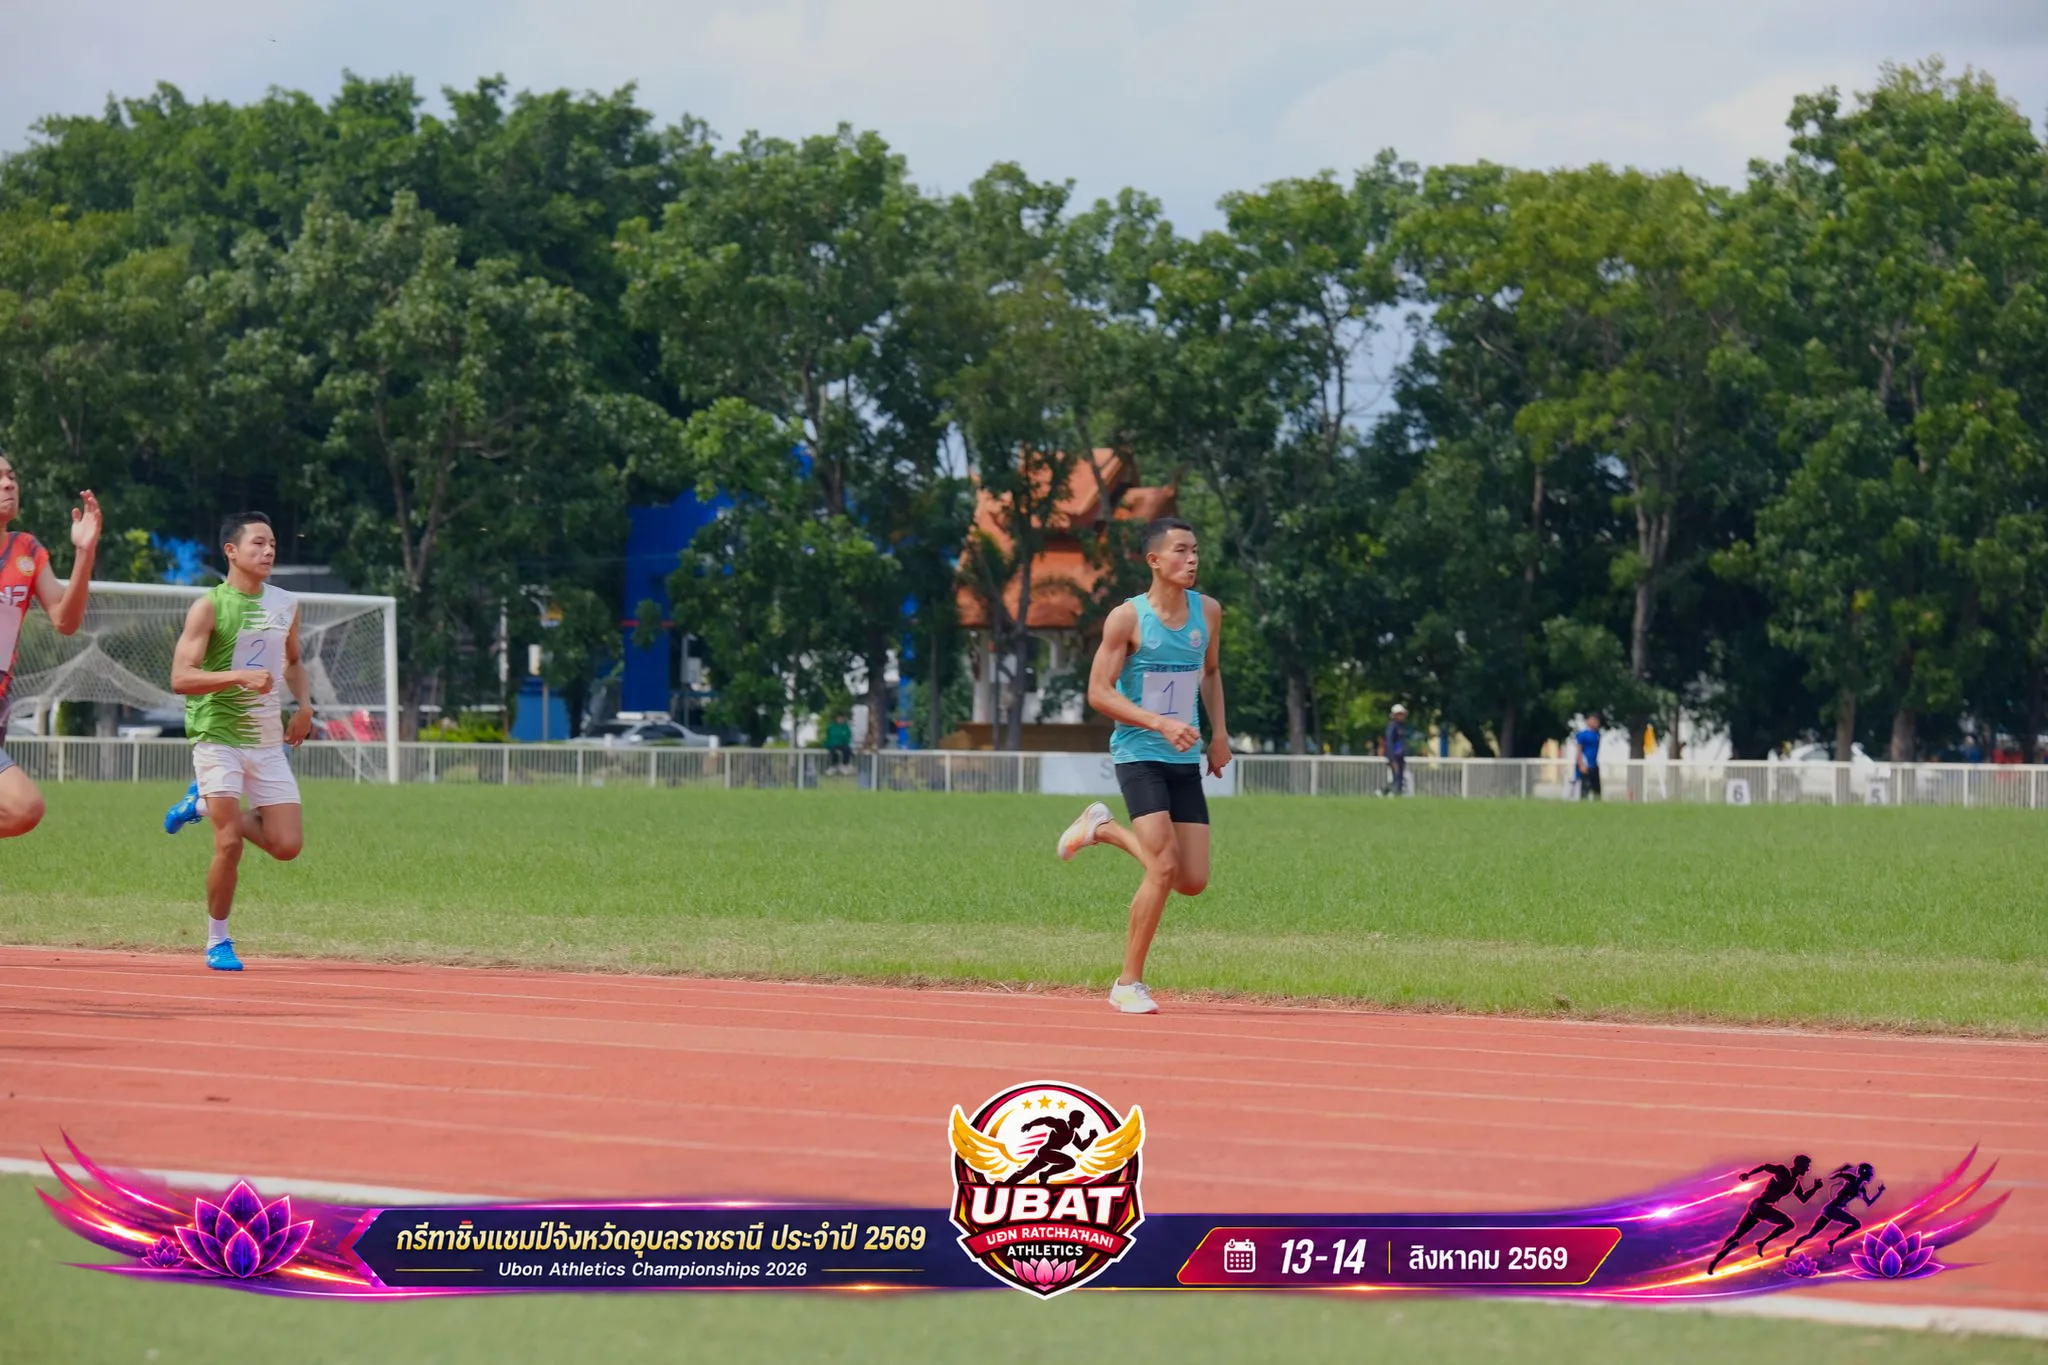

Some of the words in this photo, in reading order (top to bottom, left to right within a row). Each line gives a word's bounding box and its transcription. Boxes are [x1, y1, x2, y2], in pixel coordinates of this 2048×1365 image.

[246, 639, 267, 667] 2
[1160, 680, 1179, 715] 1
[1732, 784, 1744, 802] 6
